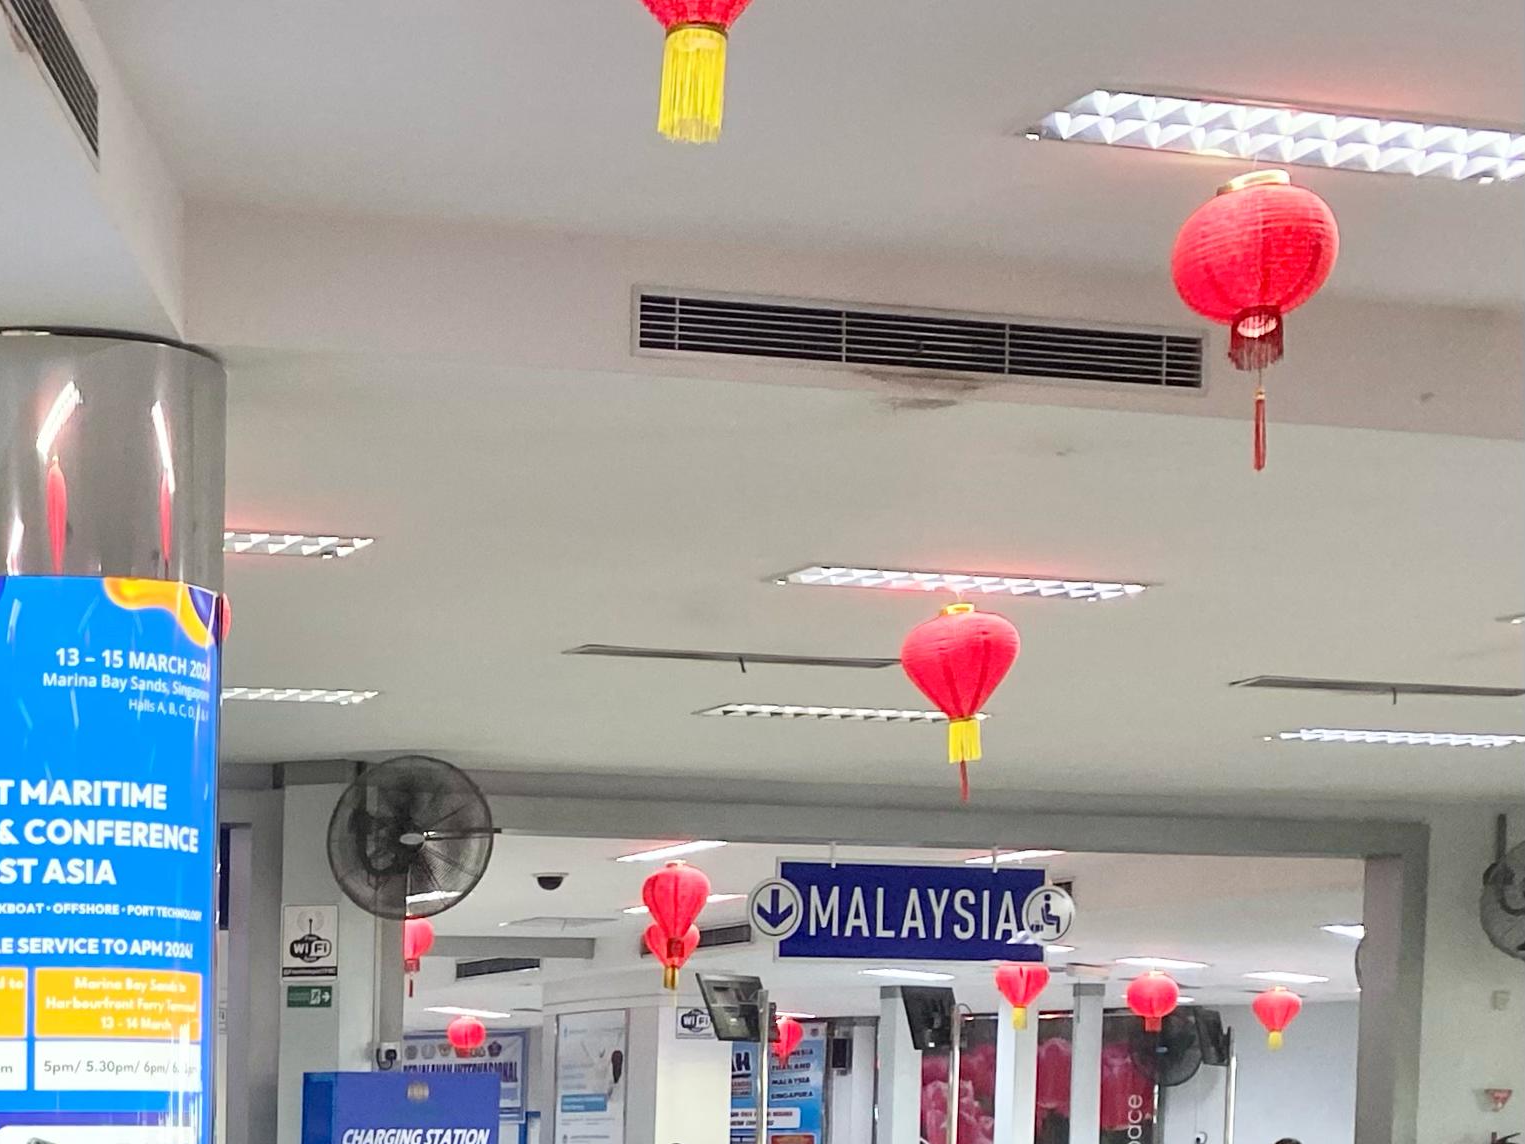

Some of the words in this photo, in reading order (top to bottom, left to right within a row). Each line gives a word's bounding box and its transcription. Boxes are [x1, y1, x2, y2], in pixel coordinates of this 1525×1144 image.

[56, 648, 79, 667] 13
[101, 650, 124, 669] 15
[129, 651, 186, 676] MARCH
[43, 672, 97, 688] Marina
[101, 674, 127, 693] Bay
[131, 676, 169, 697] Sands,
[129, 698, 155, 713] Halls
[20, 779, 167, 810] MARITIME
[24, 818, 199, 853] CONFERENCE
[42, 858, 117, 885] ASIA
[53, 903, 120, 916] OFFSHORE
[127, 904, 154, 917] PORT
[809, 885, 1018, 941] MALAYSIA
[17, 937, 99, 955] SERVICE
[102, 938, 127, 955] TO
[130, 939, 163, 957] APM
[8, 977, 24, 990] to
[74, 977, 122, 991] Marina
[125, 977, 147, 992] Bay
[43, 1060, 82, 1076] 5pm/
[86, 1060, 141, 1076] 5.30pm/
